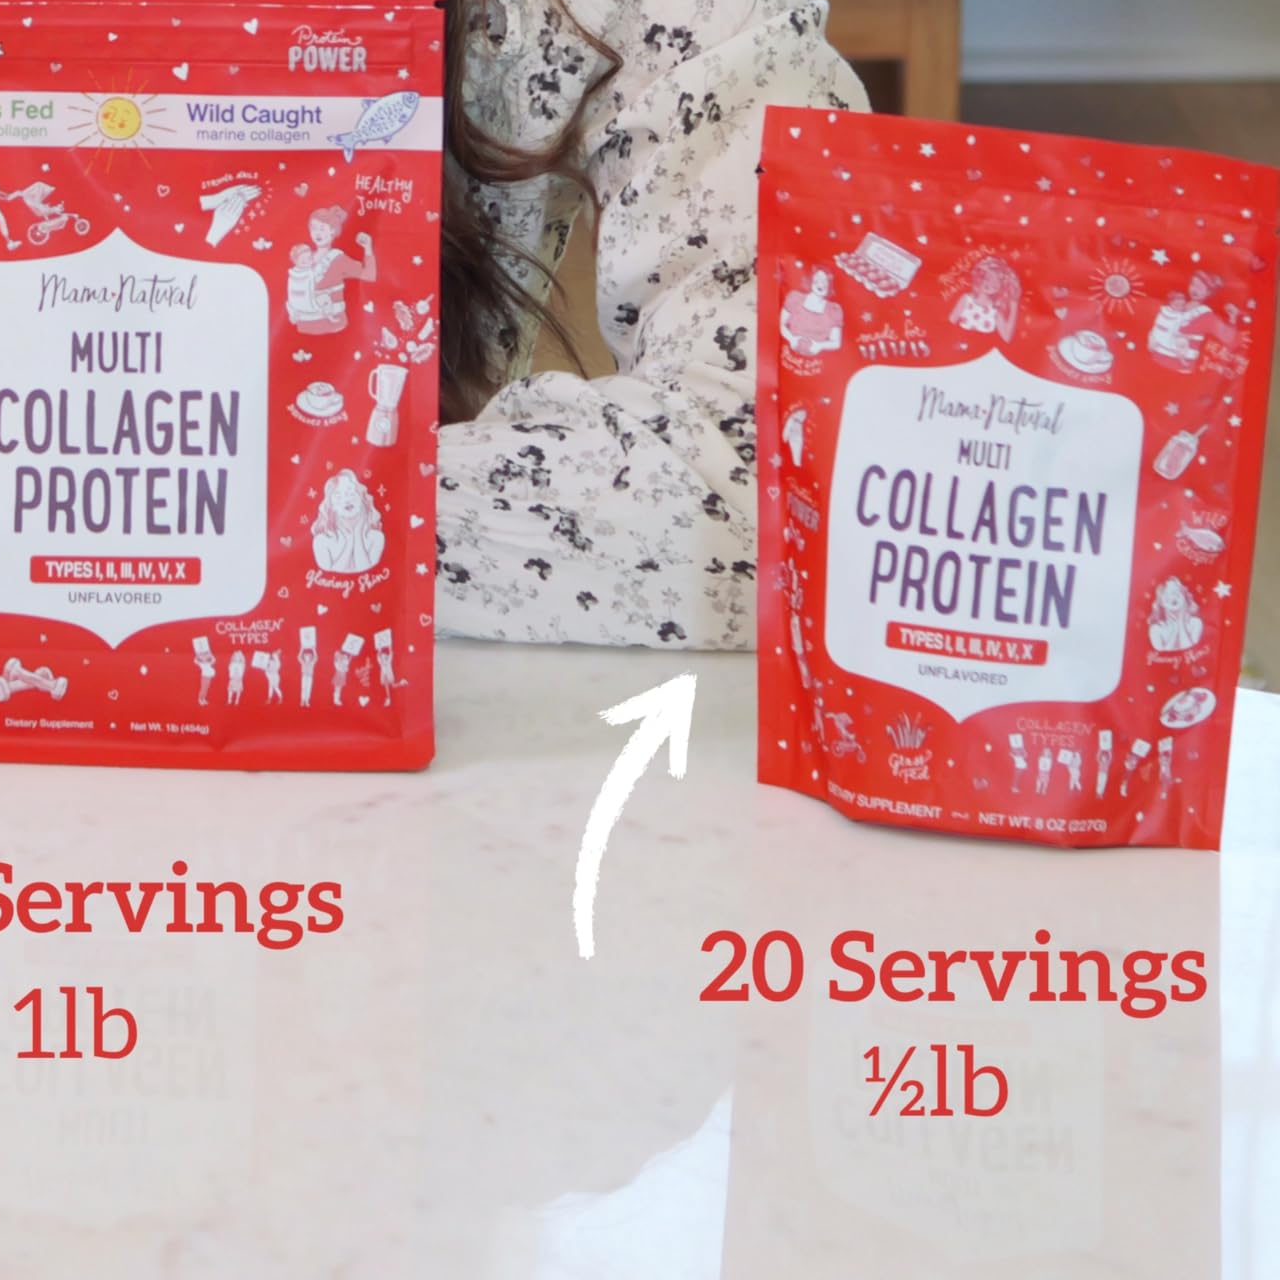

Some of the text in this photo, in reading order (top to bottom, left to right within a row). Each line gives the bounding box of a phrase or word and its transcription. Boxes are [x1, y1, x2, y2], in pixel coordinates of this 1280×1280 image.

[291, 24, 362, 45] Protein
[288, 45, 367, 72] POWER
[11, 99, 54, 119] Fed
[186, 102, 323, 129] Wild Caught
[196, 128, 310, 144] marine collagen
[355, 173, 413, 203] HEALTHY
[356, 196, 402, 217] JOINTS
[114, 274, 198, 313] Natural
[71, 331, 162, 374] MULTI
[983, 393, 1066, 435] Natural
[958, 437, 1012, 470] MULTI
[13, 466, 228, 535] PROTEIN
[856, 464, 1108, 556] COLLAGEN
[45, 561, 93, 578] TYPES
[175, 562, 186, 579] X
[869, 540, 1077, 629] PROTEIN
[68, 591, 162, 605] UNFLAVORED
[215, 618, 285, 635] COLLAGEN
[229, 632, 268, 645] TYPES
[899, 627, 943, 650] TYPES
[1021, 644, 1034, 661] X
[918, 664, 1009, 687] UNFLAVORED
[4, 717, 94, 730] Dietary Supplement
[130, 721, 146, 731] Net
[1016, 716, 1097, 736] COLLAGEN
[1030, 731, 1075, 747] TYPES
[857, 793, 943, 820] SUPPLEMENT
[979, 811, 1108, 833] NET WT. 8 OZ (227G)
